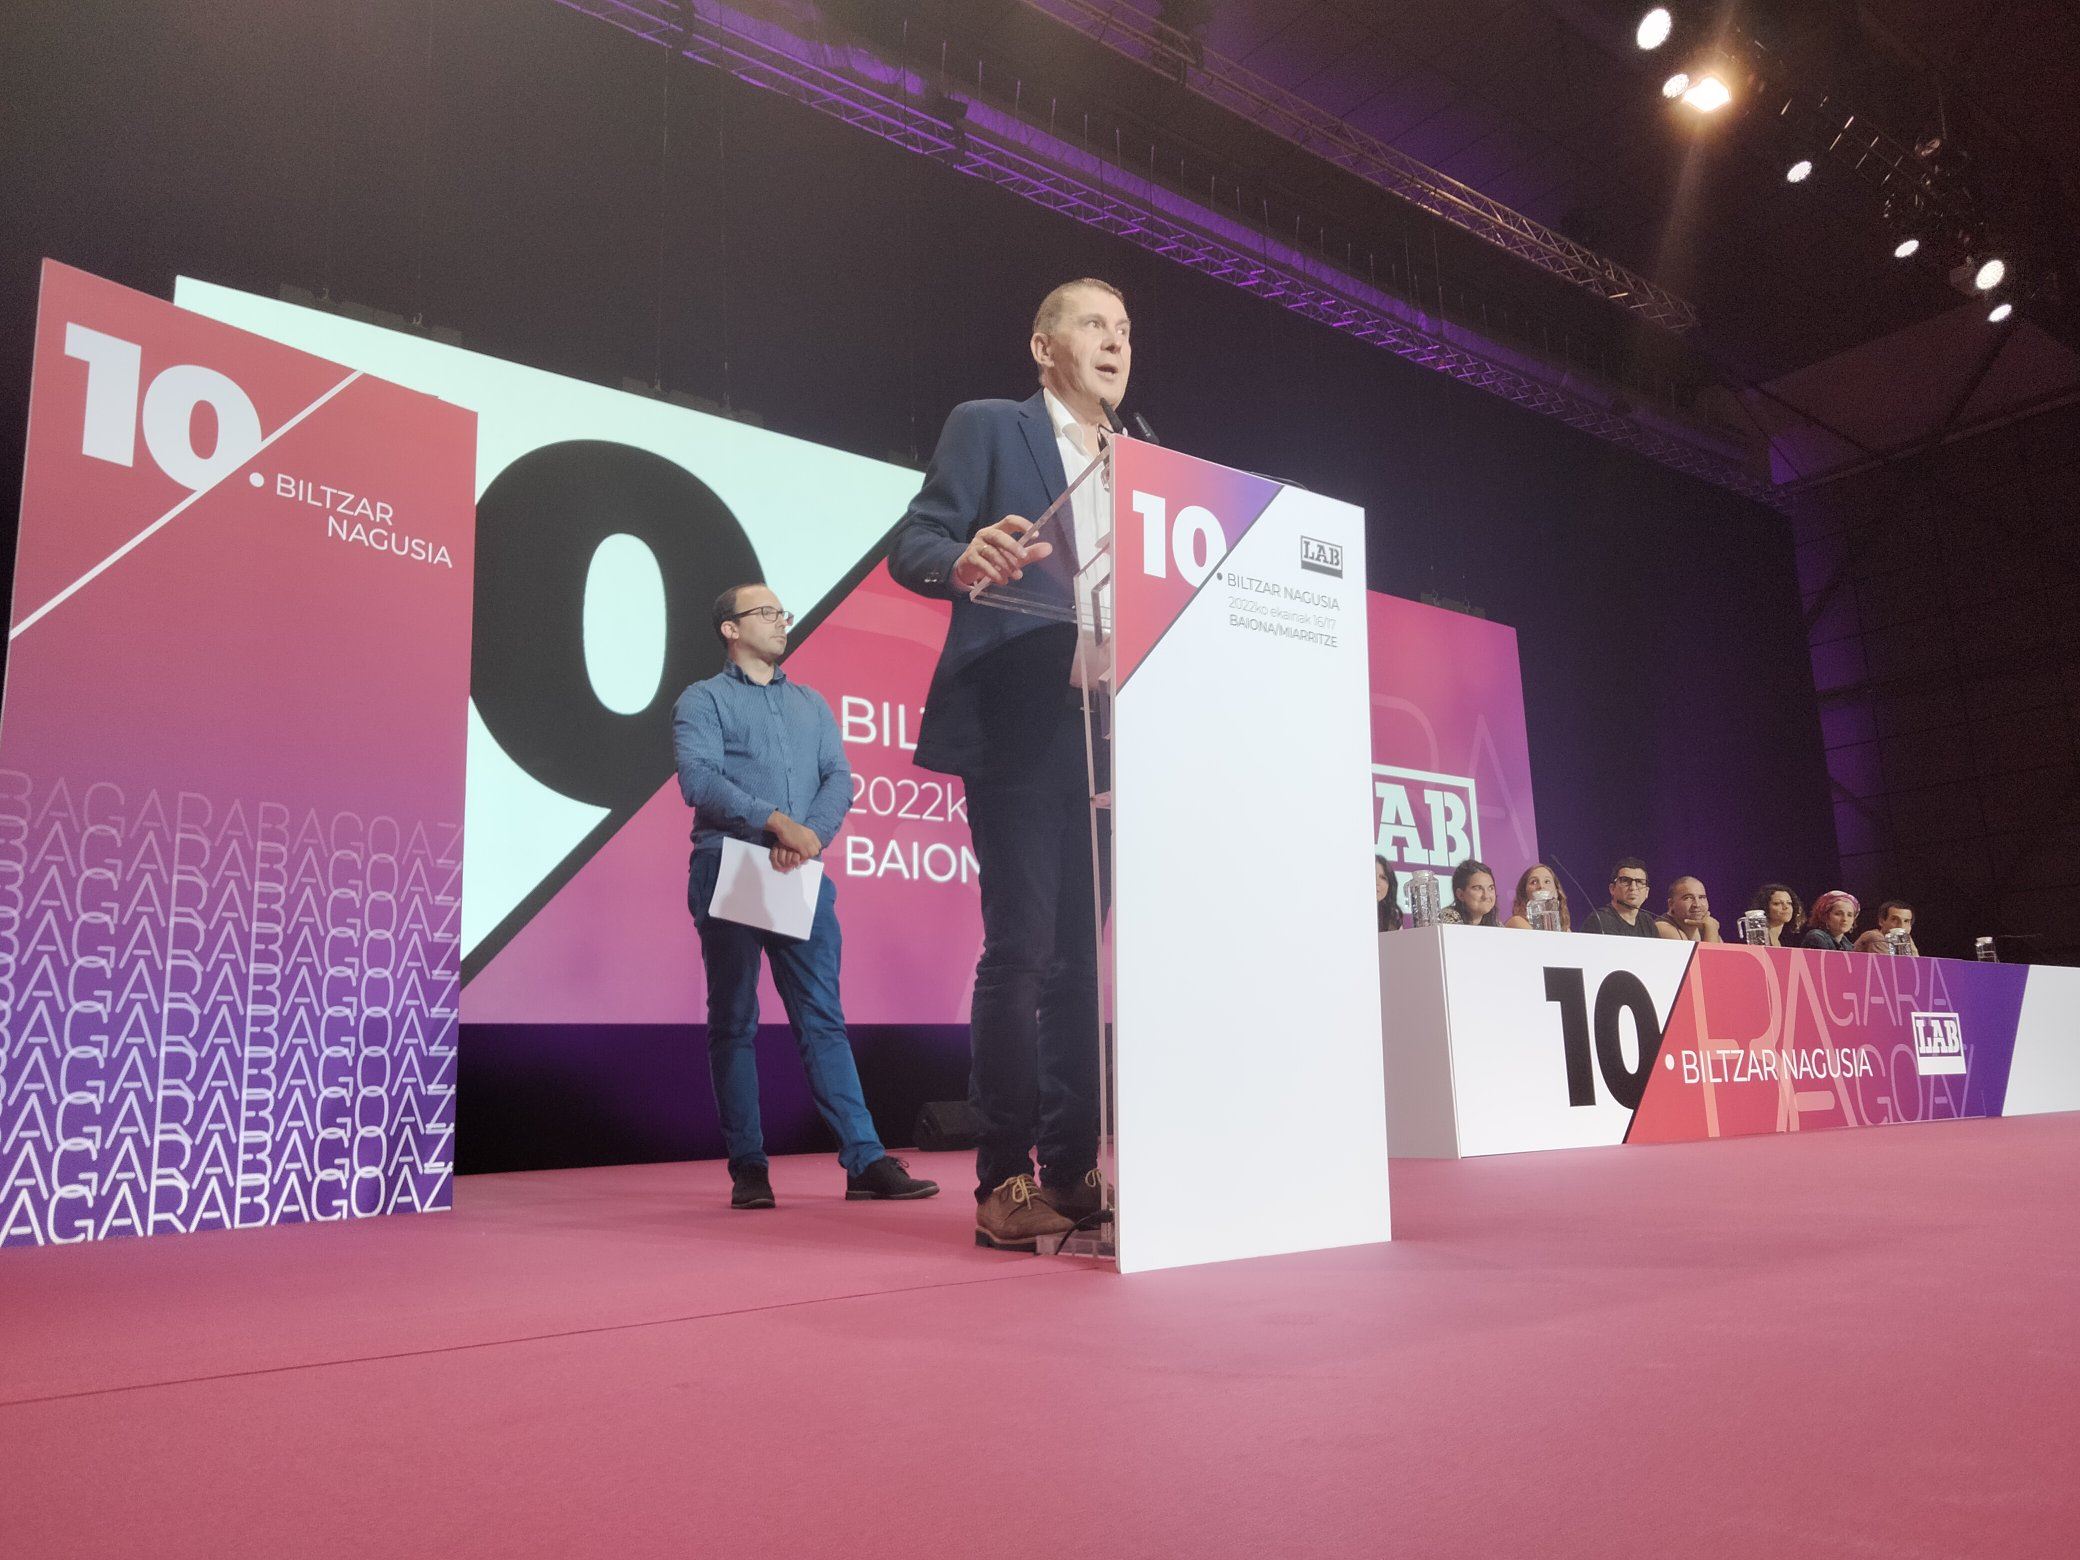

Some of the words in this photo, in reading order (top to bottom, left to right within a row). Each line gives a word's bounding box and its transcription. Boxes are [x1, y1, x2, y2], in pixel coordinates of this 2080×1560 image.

[64, 322, 262, 492] 10
[275, 473, 394, 526] BILTZAR
[327, 515, 453, 568] NAGUSIA
[1132, 489, 1228, 590] 10
[1303, 540, 1341, 567] LAB
[1227, 573, 1281, 598] BILTZAR
[1283, 586, 1340, 611] NAGUSIA
[1229, 614, 1339, 649] BAIONA/MIARRITZE
[1543, 966, 1664, 1110] 10
[1916, 1019, 1960, 1055] LAB
[1681, 1050, 1778, 1084] BILTZAR
[1781, 1047, 1874, 1080] NAGUSIA
